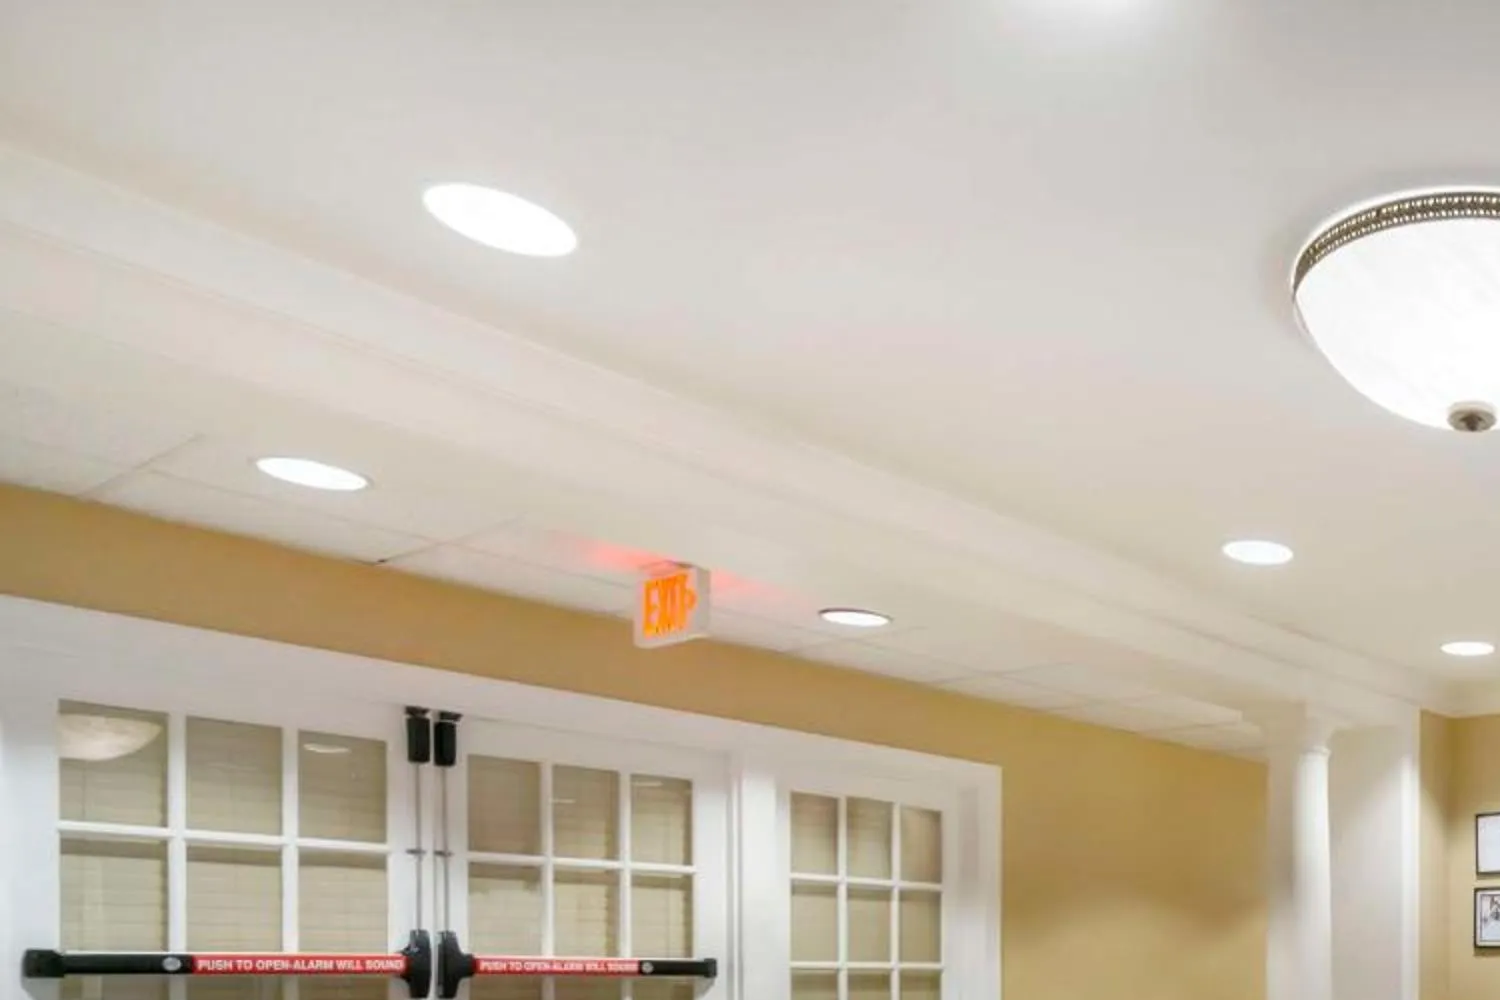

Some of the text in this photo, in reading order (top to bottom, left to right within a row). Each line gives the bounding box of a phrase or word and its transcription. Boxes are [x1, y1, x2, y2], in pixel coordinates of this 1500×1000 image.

[643, 574, 689, 638] EXIT
[197, 959, 233, 971] PUSH
[236, 959, 253, 971] TO
[335, 959, 364, 971] WILL
[365, 959, 405, 971] SOUND
[479, 960, 507, 972] PUSH
[509, 961, 522, 972] TO
